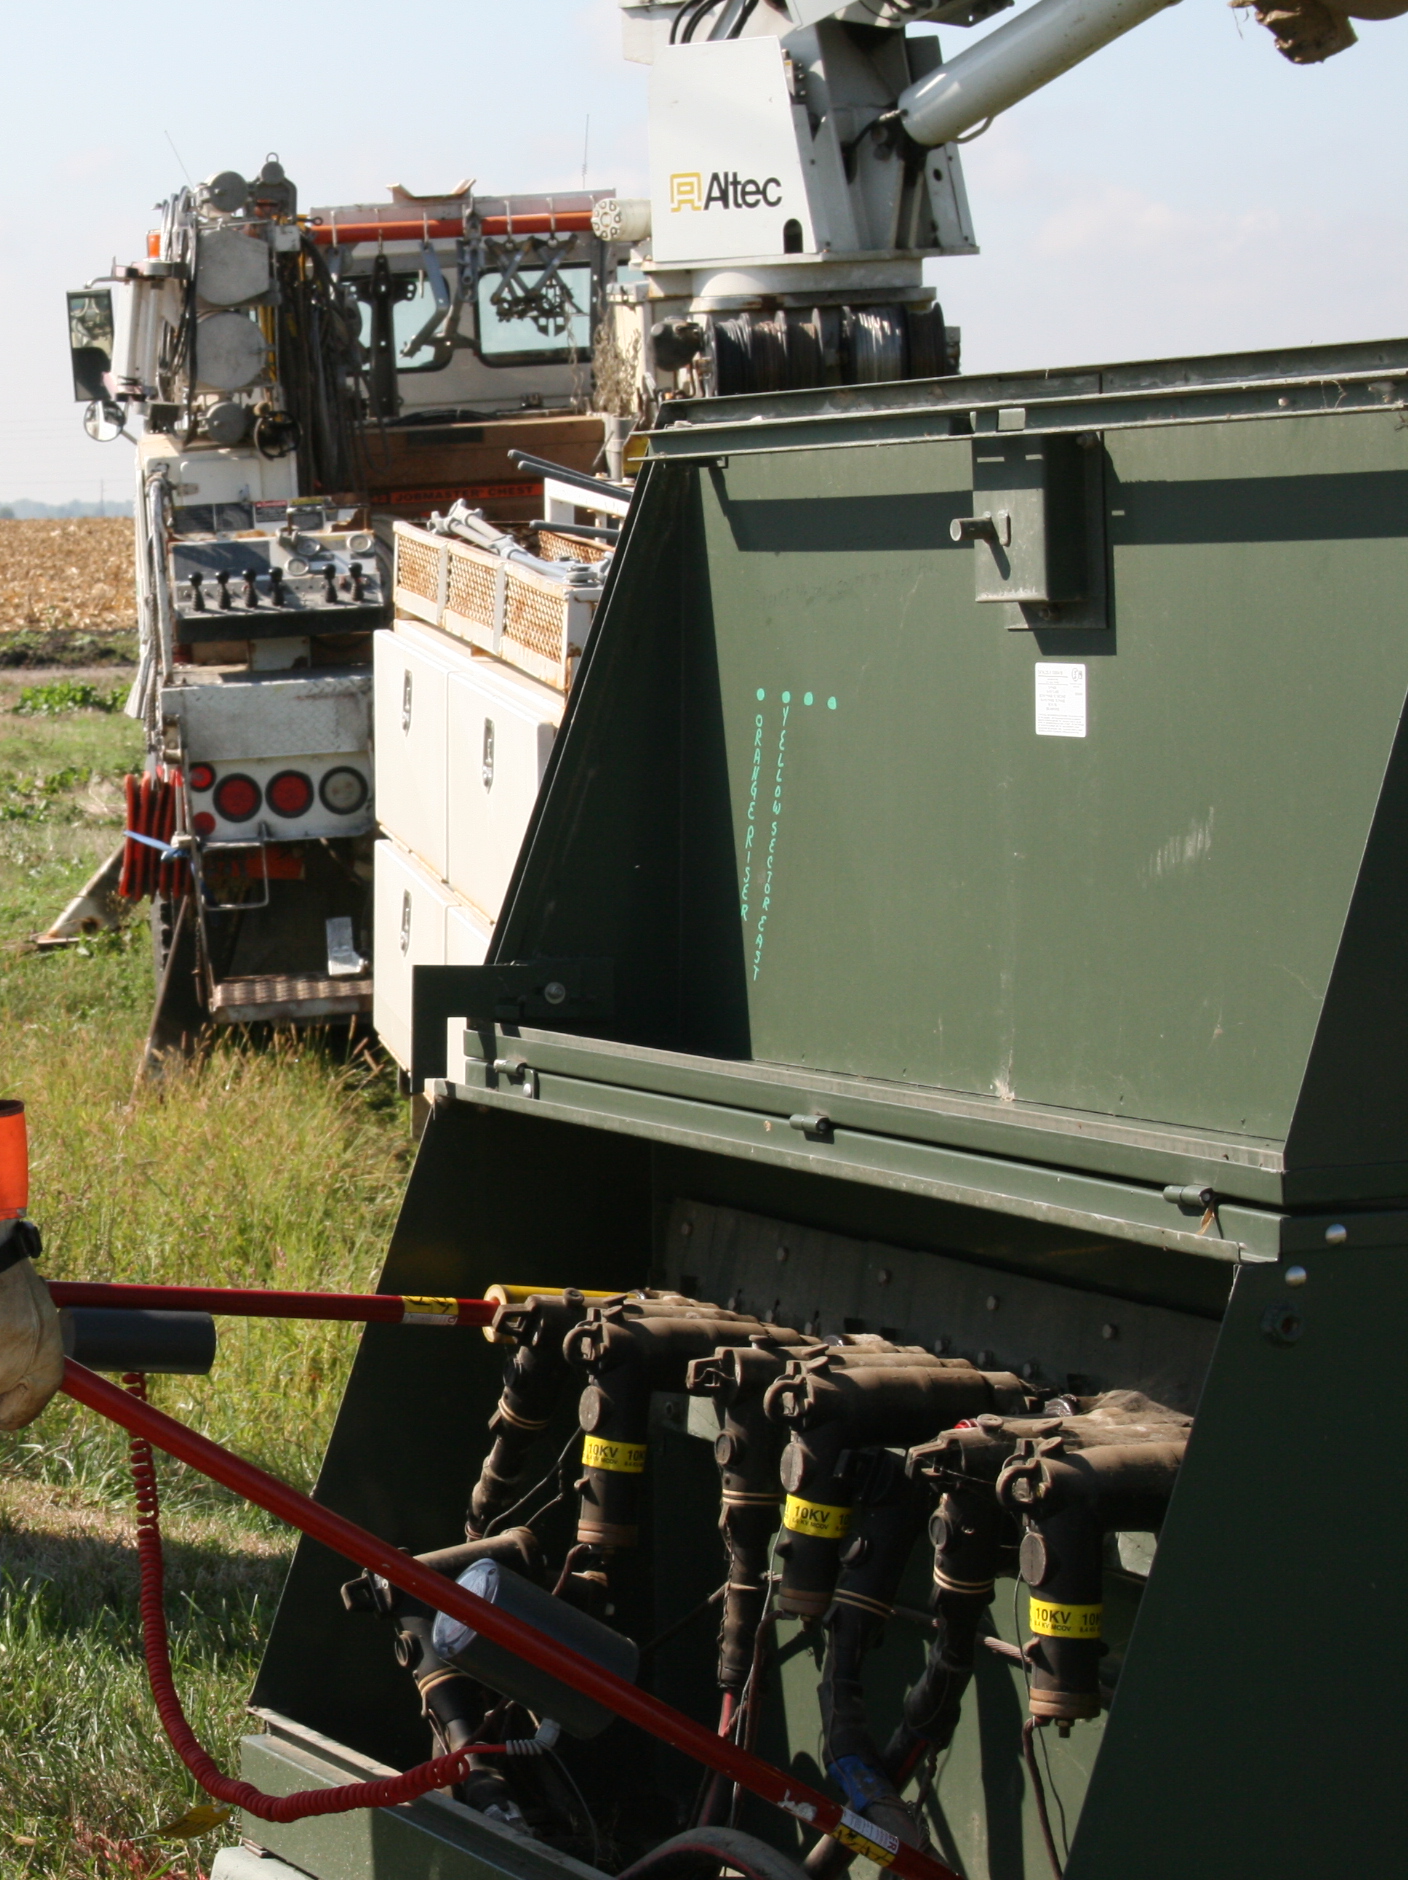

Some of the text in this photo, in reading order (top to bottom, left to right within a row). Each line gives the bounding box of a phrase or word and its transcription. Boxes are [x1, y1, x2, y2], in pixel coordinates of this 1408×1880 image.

[703, 171, 782, 211] Altec
[396, 488, 478, 501] JOBMASTER
[488, 485, 533, 496] CHEST
[740, 713, 763, 922] ORANGE RISER
[753, 705, 790, 981] YELLOW SECTOR EAST
[588, 1443, 619, 1459] 10KV
[795, 1505, 831, 1523] 10KV
[1036, 1607, 1072, 1625] 10KV
